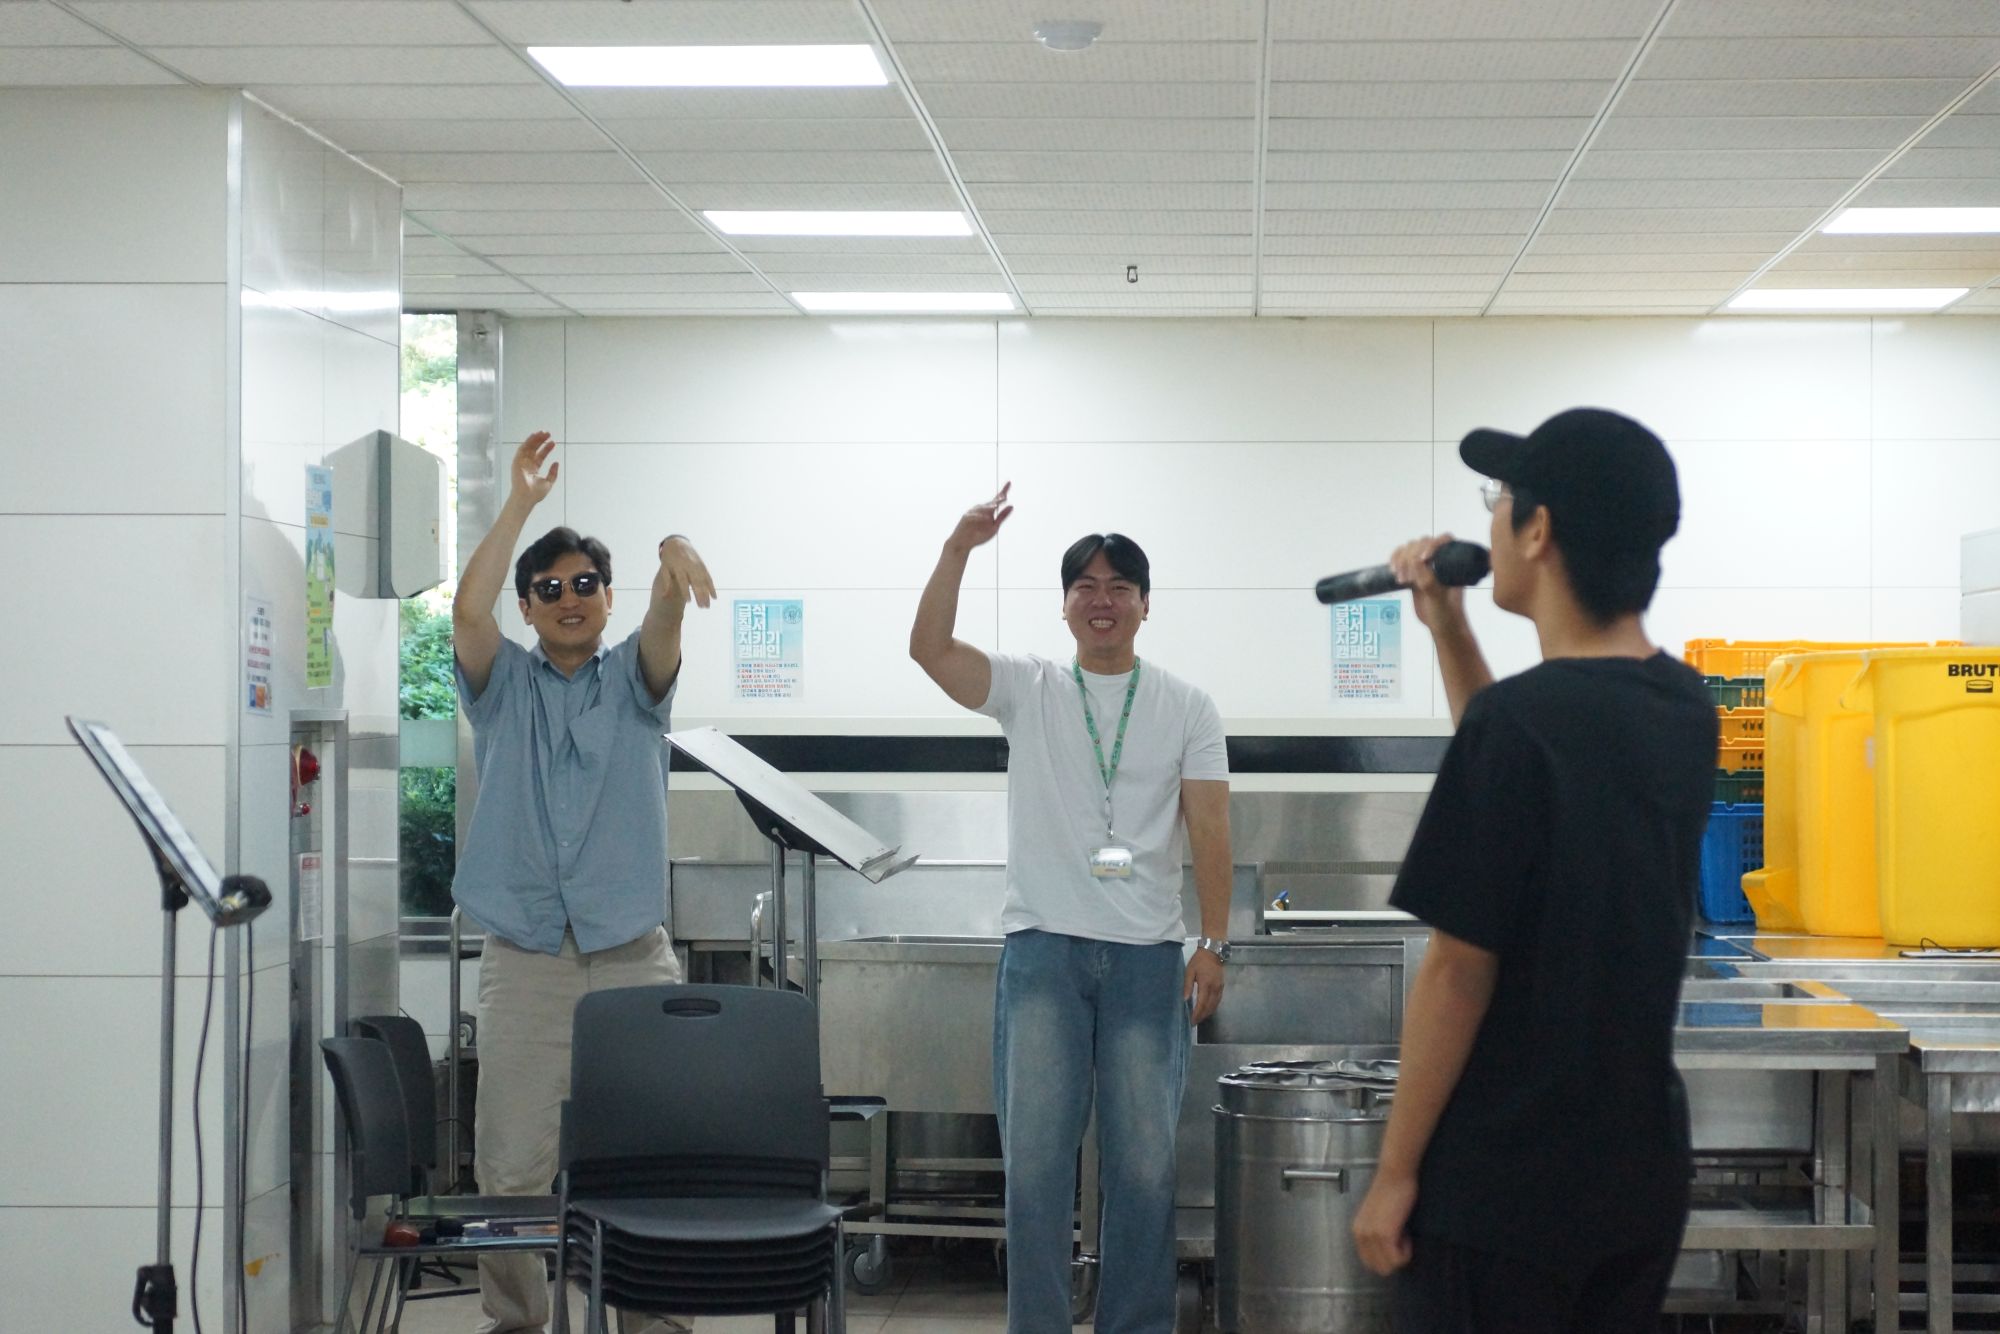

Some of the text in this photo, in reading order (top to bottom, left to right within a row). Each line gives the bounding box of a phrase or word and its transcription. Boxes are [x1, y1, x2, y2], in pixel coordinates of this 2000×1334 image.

[738, 604, 765, 617] 급식
[1335, 604, 1363, 617] 급식
[738, 617, 765, 631] 질서
[1335, 617, 1363, 631] 질서
[737, 631, 780, 645] 지키기
[1335, 631, 1378, 645] 지키기
[737, 645, 780, 659] 캠페인
[1335, 645, 1378, 659] 캠페인
[1948, 664, 2000, 677] BRUT
